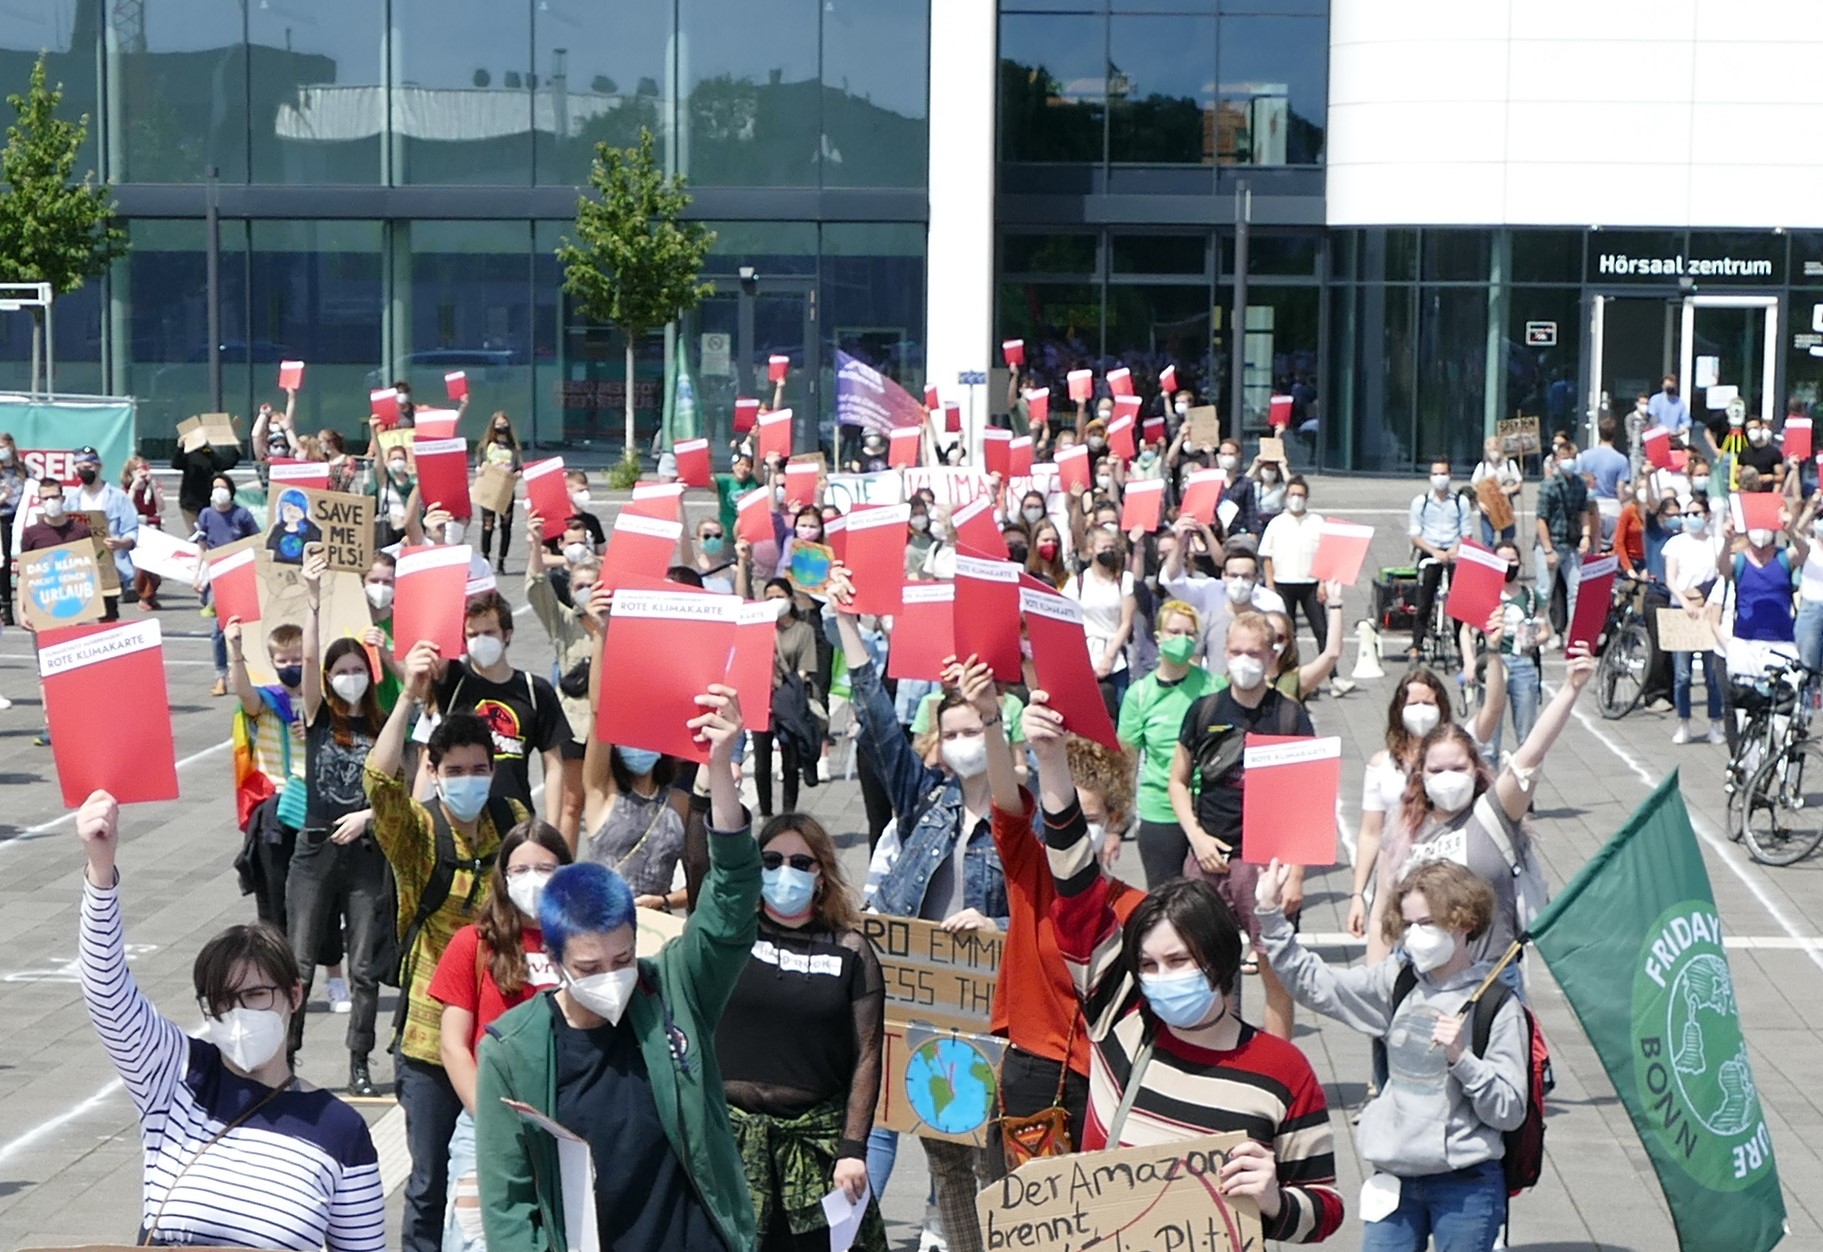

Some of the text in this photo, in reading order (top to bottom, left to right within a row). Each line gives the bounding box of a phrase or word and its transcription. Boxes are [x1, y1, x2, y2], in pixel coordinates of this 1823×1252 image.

[315, 499, 363, 525] SAVE
[330, 526, 363, 547] ME,
[26, 553, 93, 575] DAS KLIMA
[327, 545, 364, 568] PLS!
[39, 580, 95, 605] URLAUB
[620, 601, 723, 616] ROTE KLIMAKARTE
[47, 634, 144, 669] ROTE KLIMAKARTE
[1639, 1035, 1698, 1160] BONN
[1000, 1172, 1062, 1210] Der
[987, 1202, 1099, 1251] brennt,
